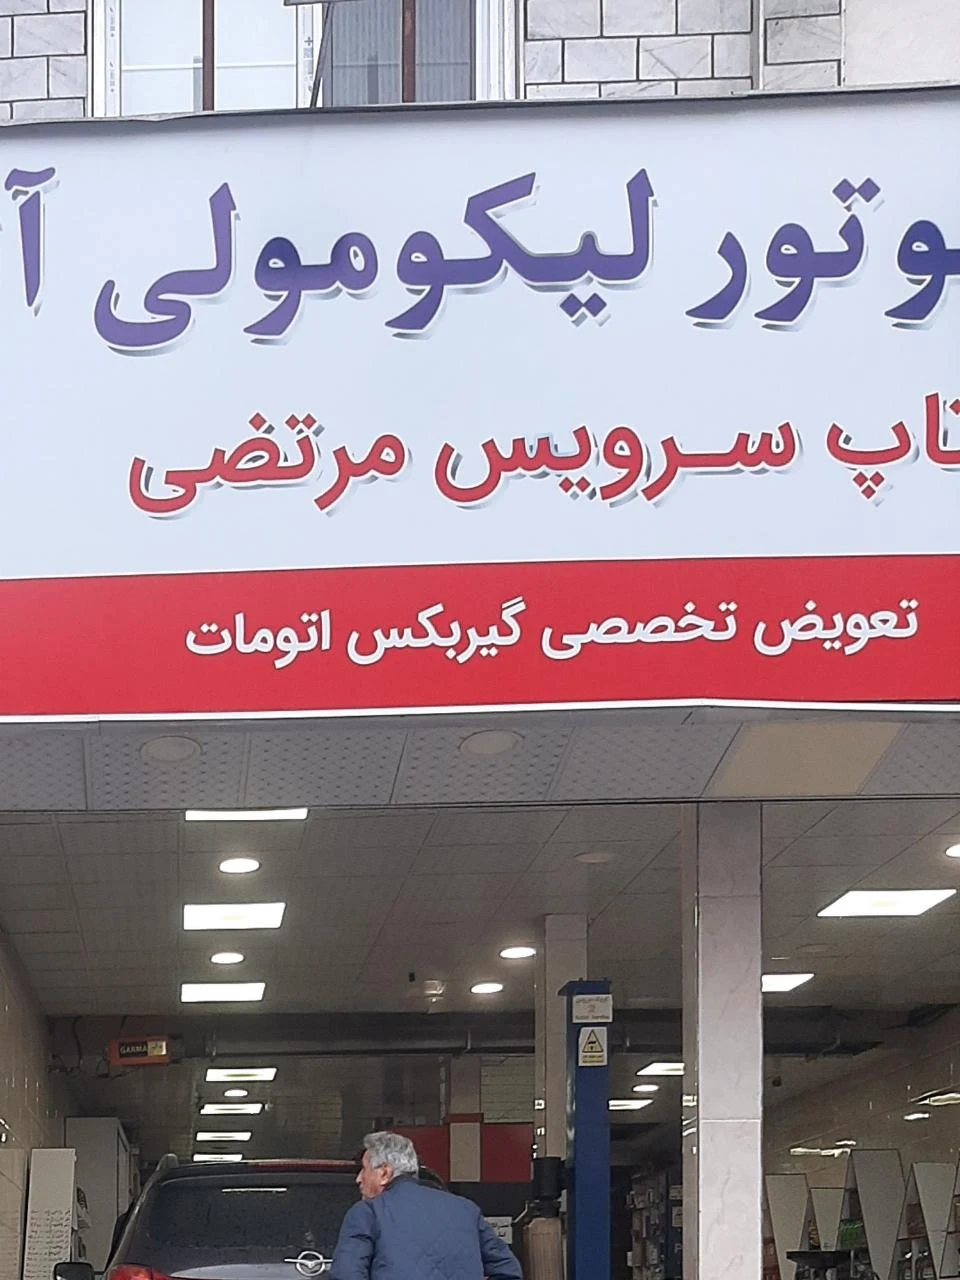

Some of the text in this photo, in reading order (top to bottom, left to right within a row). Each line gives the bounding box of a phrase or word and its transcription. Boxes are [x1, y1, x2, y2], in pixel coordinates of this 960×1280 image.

[93, 168, 655, 350] لیکومولی
[687, 177, 960, 323] وتور
[129, 411, 405, 514] مرتضی
[434, 420, 797, 502] سرویس
[186, 596, 919, 669] تعویض تخصصی گیربکس اتومات
